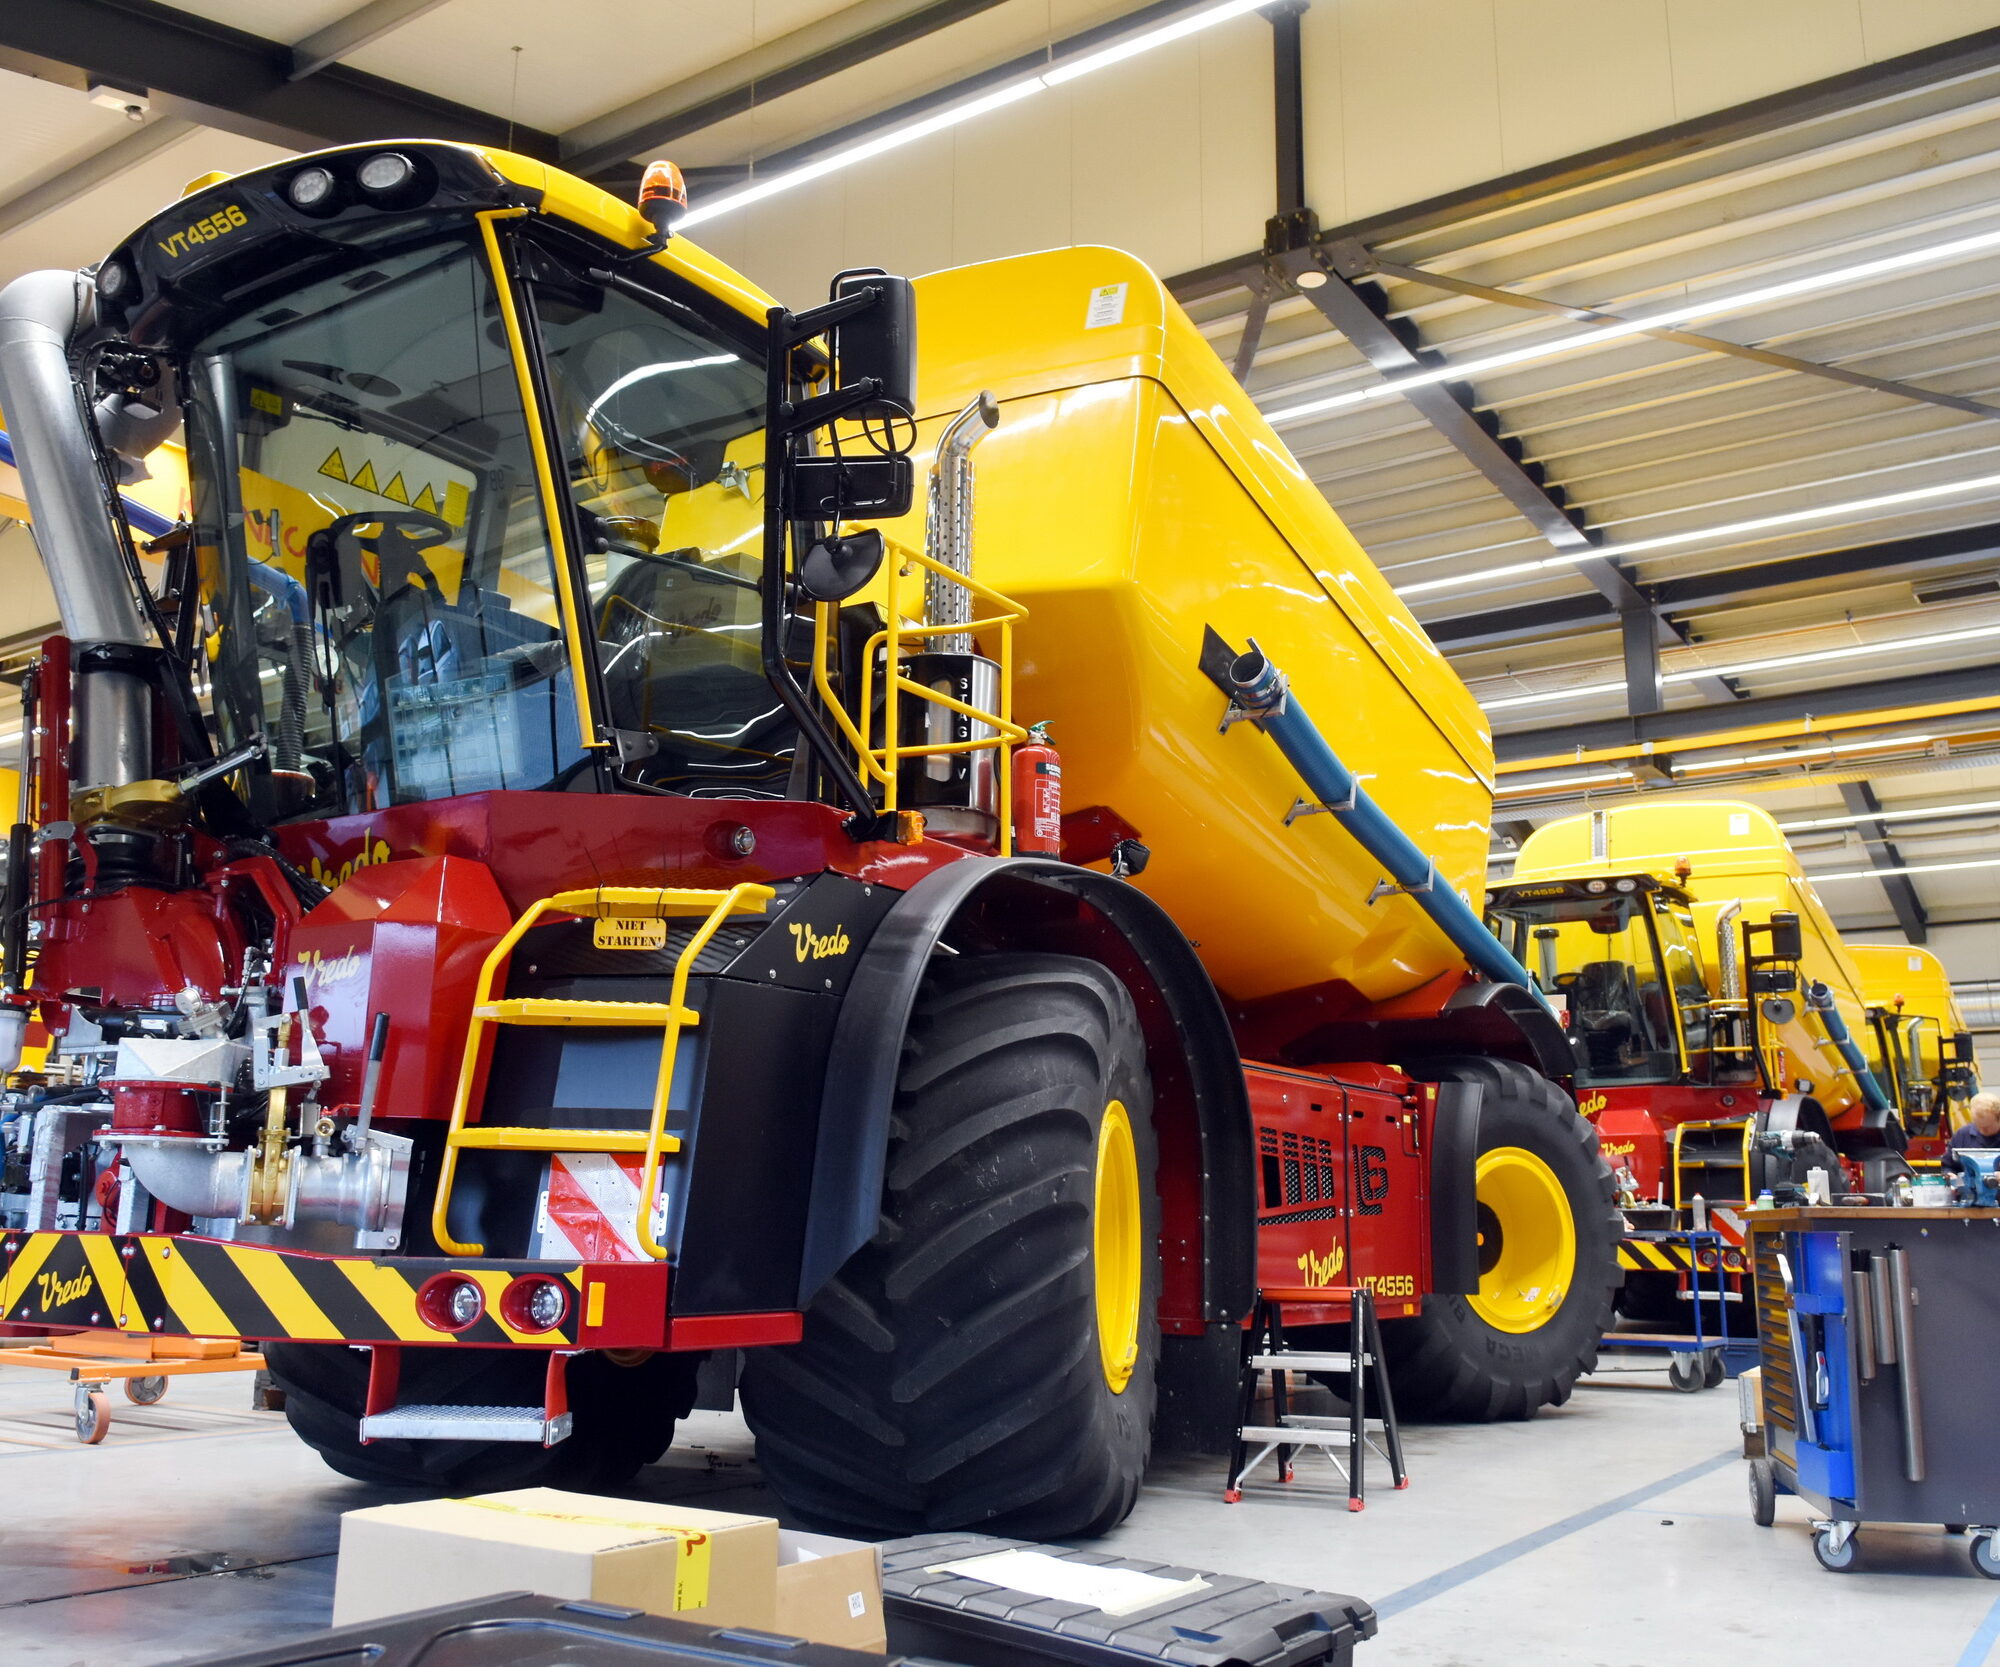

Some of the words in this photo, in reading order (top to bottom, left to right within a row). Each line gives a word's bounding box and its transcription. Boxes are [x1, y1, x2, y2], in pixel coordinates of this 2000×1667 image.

[158, 204, 248, 258] VT4556
[957, 677, 969, 754] STAG
[616, 920, 647, 931] NIET
[788, 922, 850, 963] Vredo
[297, 944, 361, 989] Vredo
[1579, 1090, 1607, 1118] edo
[1600, 1140, 1636, 1158] Vredo
[1297, 1235, 1345, 1288] Vredo
[37, 1264, 93, 1313] Vredo
[1357, 1274, 1415, 1297] VT4556
